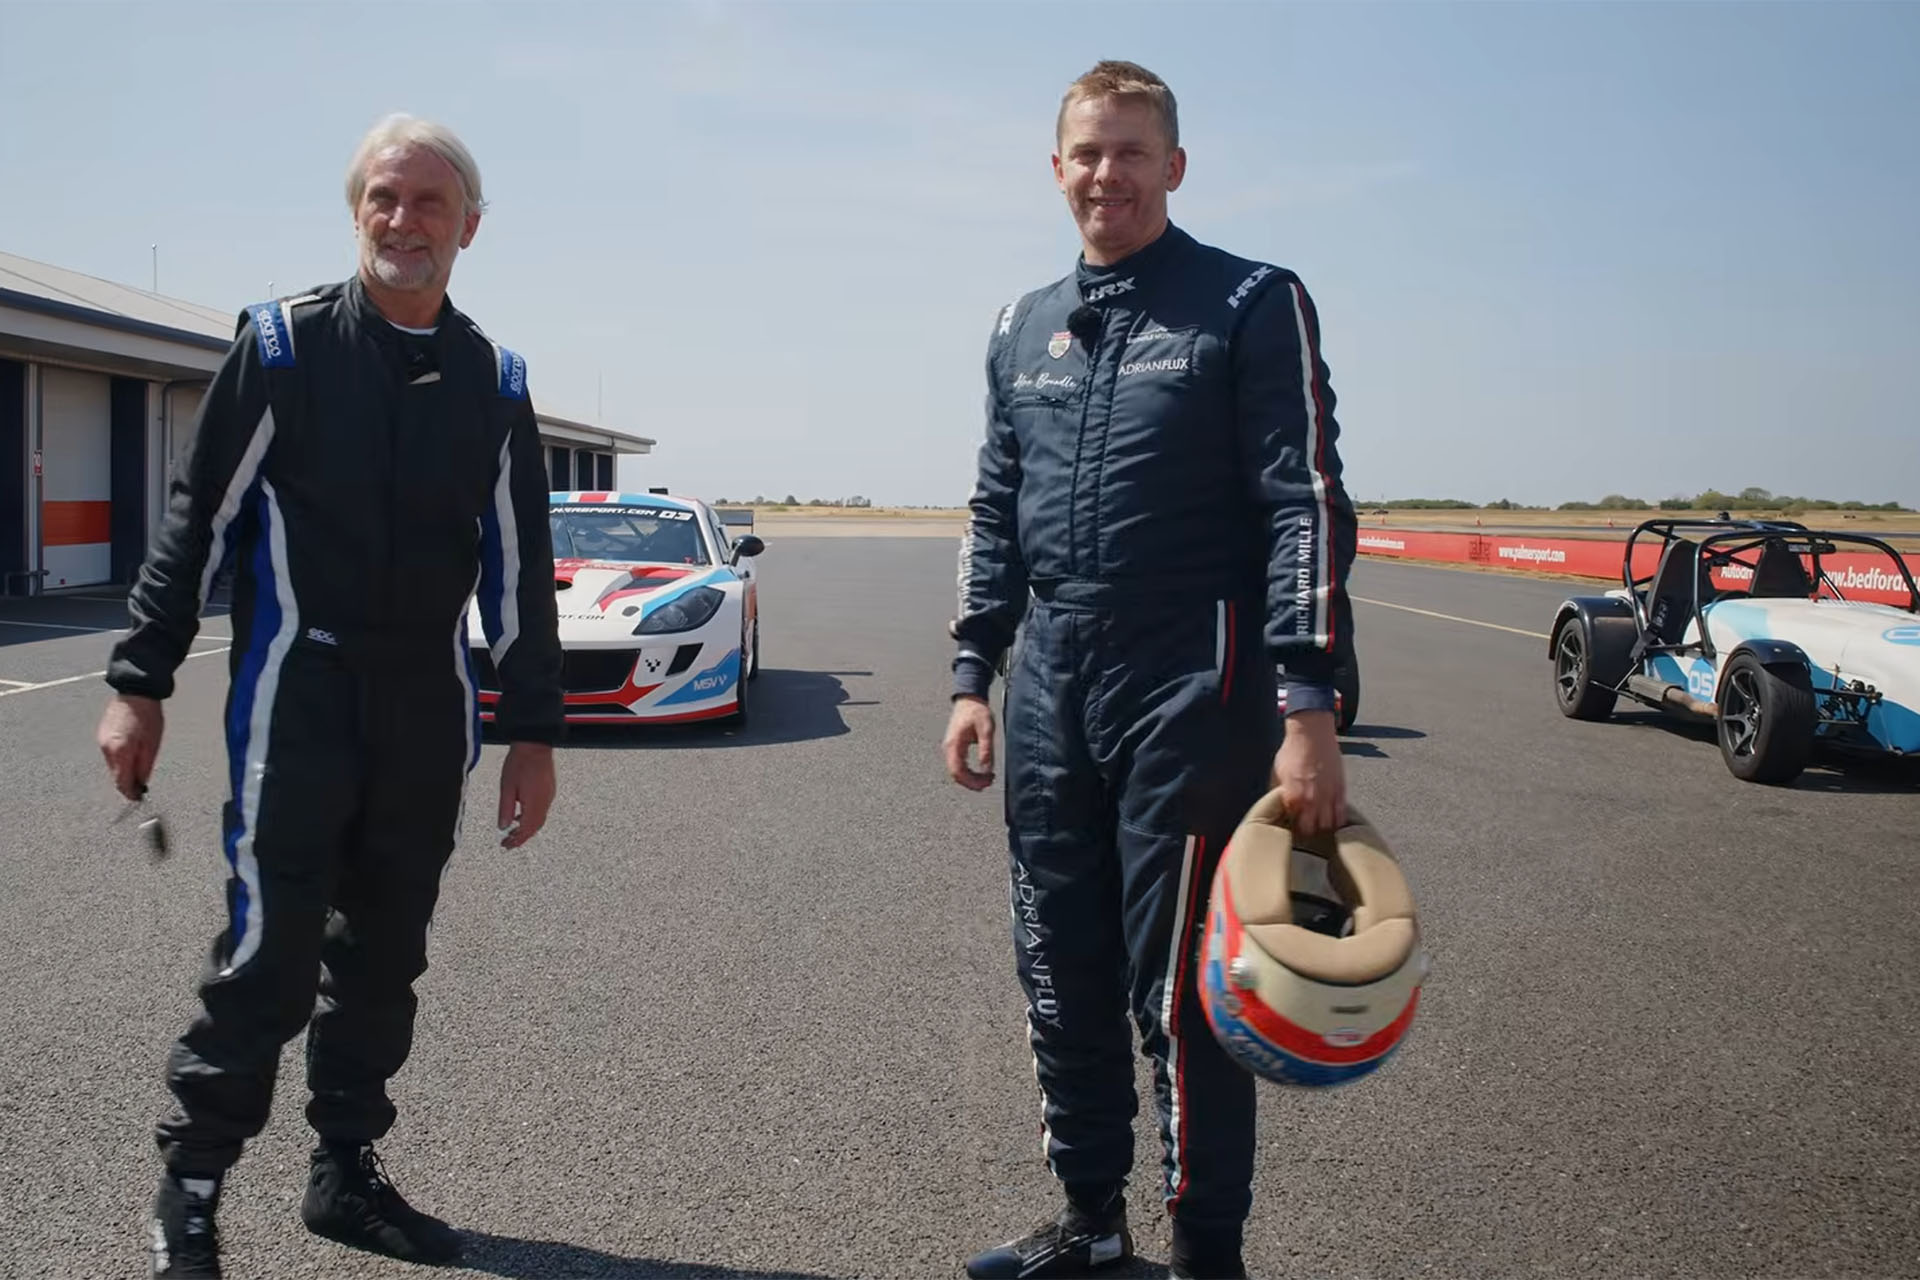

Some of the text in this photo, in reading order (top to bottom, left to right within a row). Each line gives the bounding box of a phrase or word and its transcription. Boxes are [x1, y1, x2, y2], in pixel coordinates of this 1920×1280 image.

[256, 309, 281, 358] sparco
[1117, 357, 1189, 376] ADRIANFLUX
[1296, 517, 1313, 635] RICHARD MILLE
[1017, 860, 1064, 1030] ADRIANFLUX
